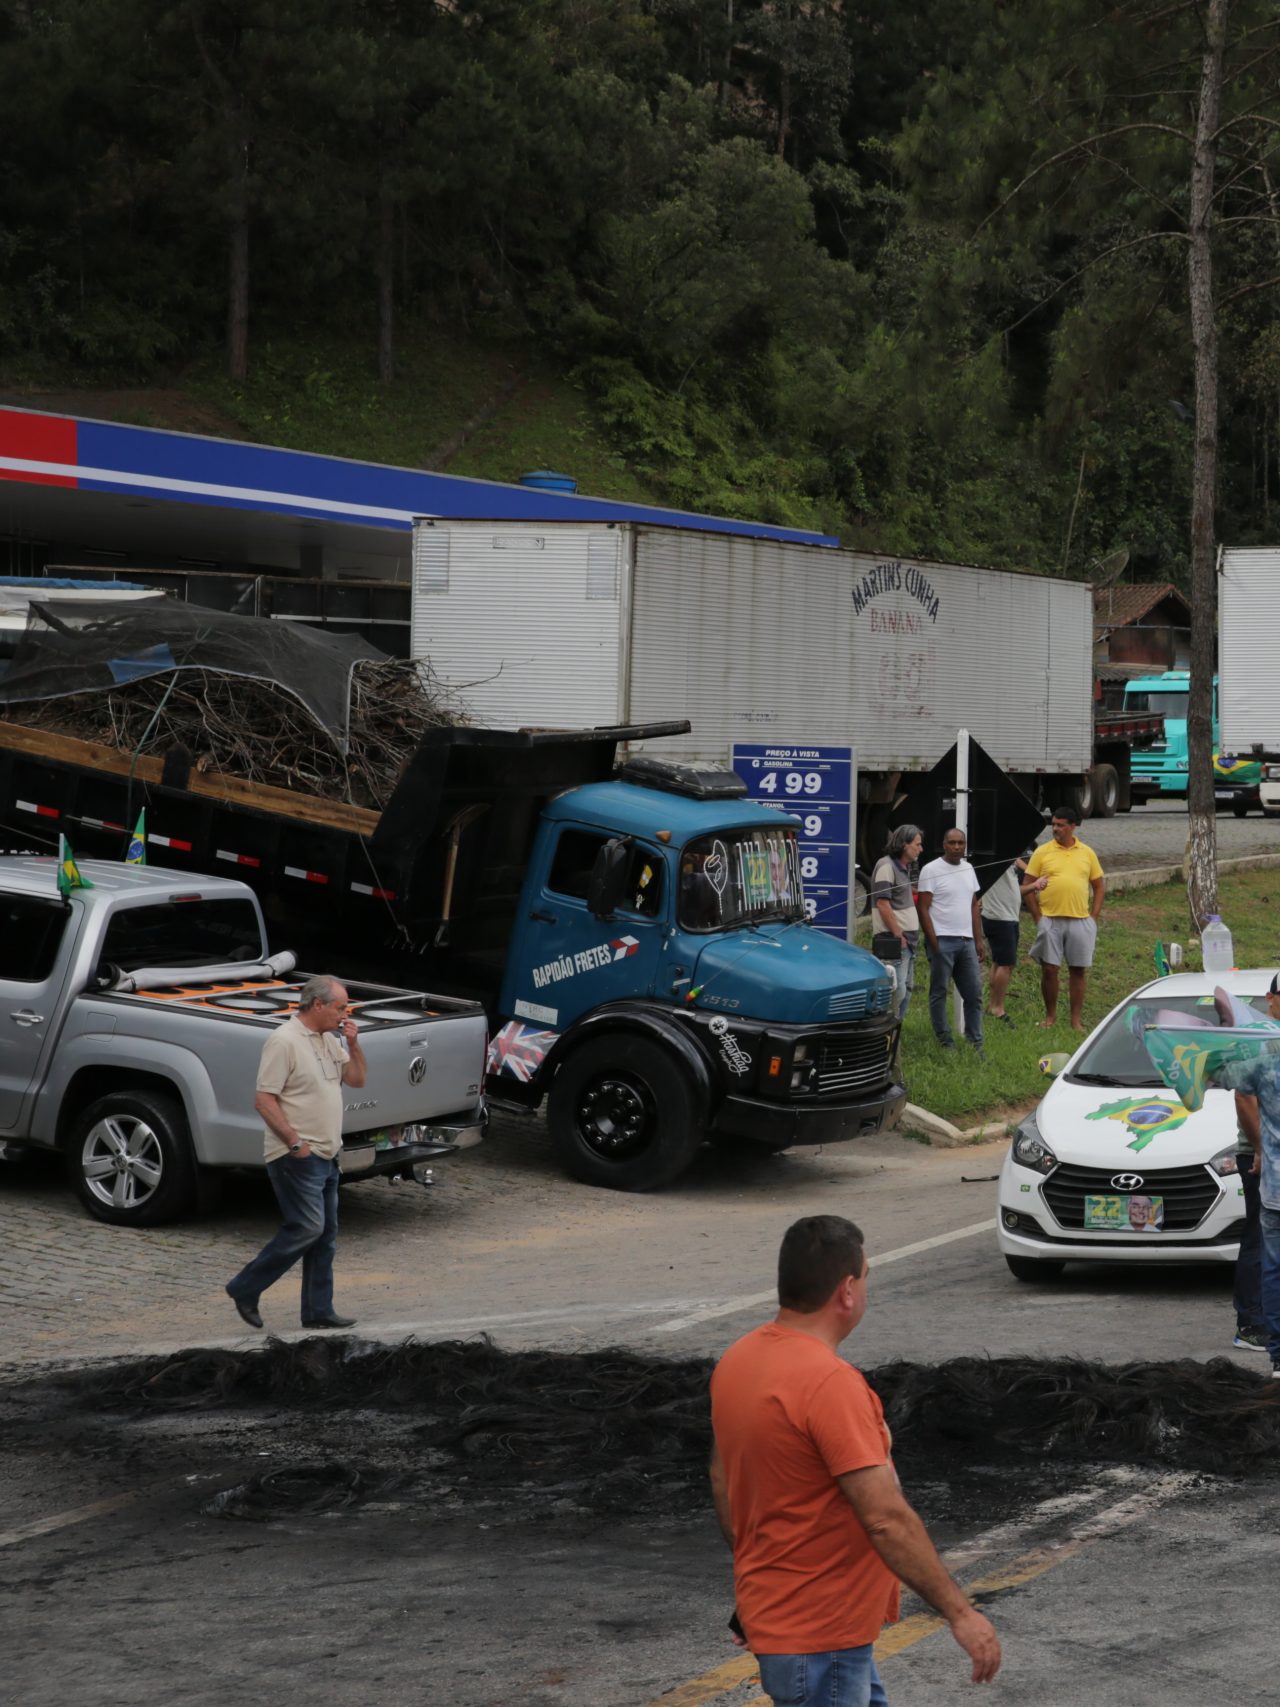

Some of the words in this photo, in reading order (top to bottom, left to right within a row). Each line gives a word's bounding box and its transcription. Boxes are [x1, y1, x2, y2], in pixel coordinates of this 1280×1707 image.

[851, 562, 902, 616] MARTINS
[905, 567, 940, 624] CUNHA
[751, 759, 760, 768] G
[765, 749, 791, 758] PREÇO
[799, 750, 820, 758] VISTA
[758, 772, 777, 793] 4
[784, 772, 822, 795] 99
[532, 954, 575, 989] RAPIDÃO
[574, 943, 612, 974] FRETES
[1087, 1195, 1121, 1217] 22
